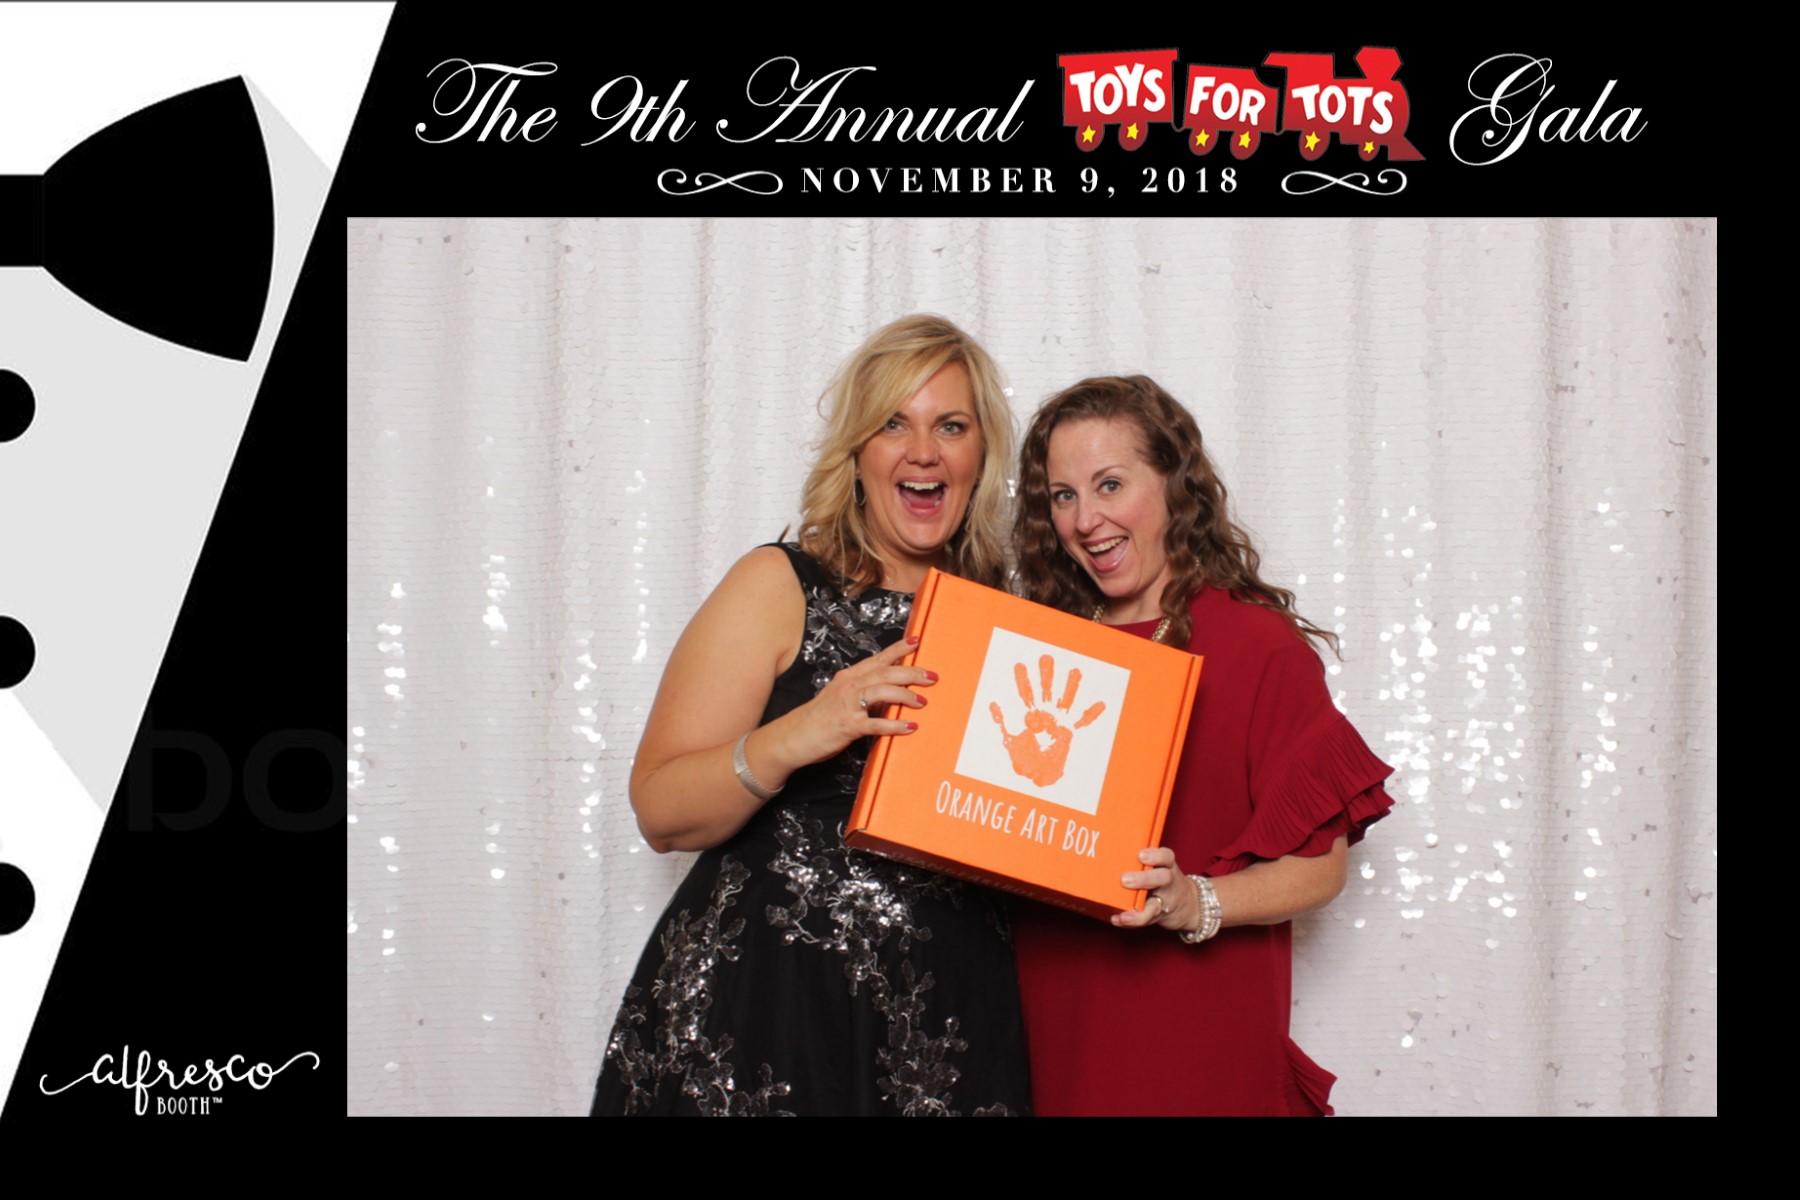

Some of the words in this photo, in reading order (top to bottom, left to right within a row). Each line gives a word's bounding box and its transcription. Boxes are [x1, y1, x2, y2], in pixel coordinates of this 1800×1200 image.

[935, 780, 1017, 834] ORANGE
[1019, 807, 1059, 846] ART
[1062, 819, 1100, 859] BOX
